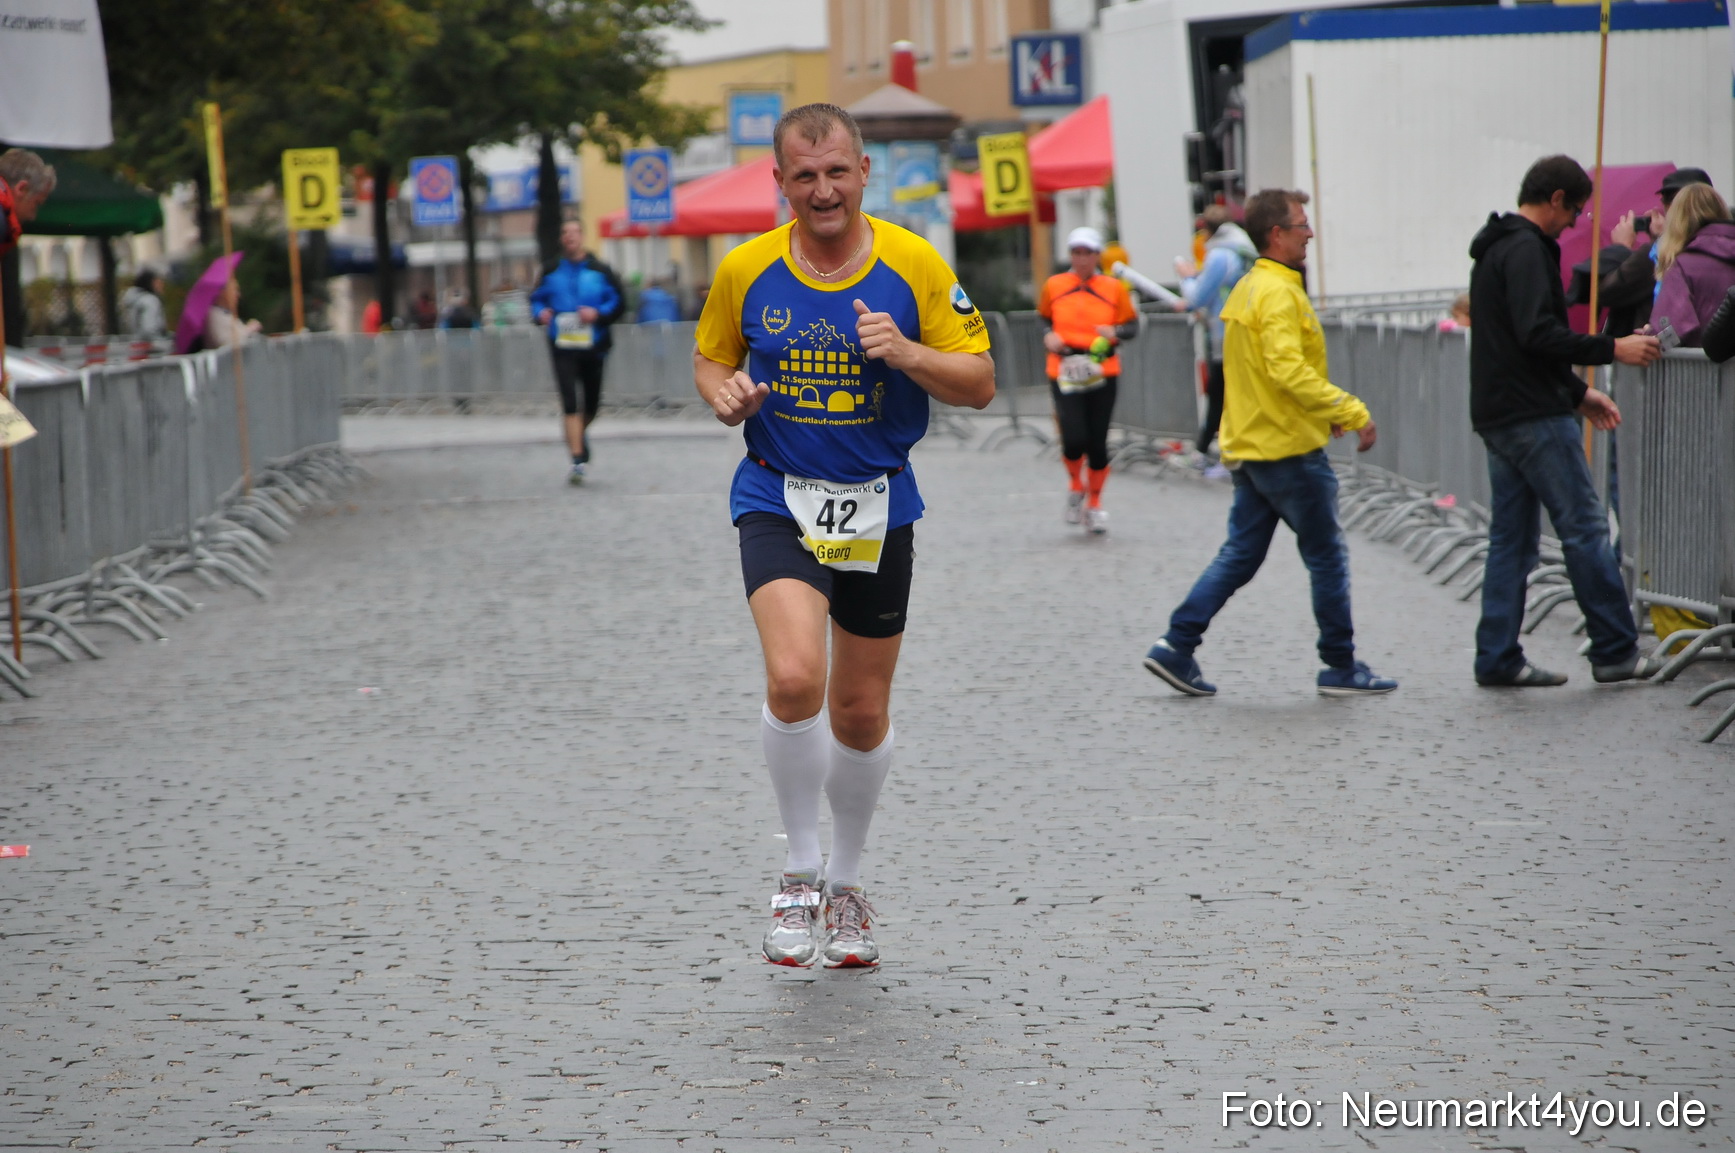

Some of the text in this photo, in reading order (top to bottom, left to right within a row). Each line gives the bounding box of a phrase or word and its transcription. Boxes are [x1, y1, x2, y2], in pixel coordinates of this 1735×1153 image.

[996, 159, 1021, 194] D
[300, 174, 325, 209] D
[767, 316, 785, 324] Jahre
[781, 374, 860, 387] 21.September 2014
[774, 410, 874, 426] www.stadtlauf-neumarkt.de
[787, 480, 871, 496] PARTL Neumarkt
[816, 499, 857, 534] 42
[816, 545, 851, 560] Georg
